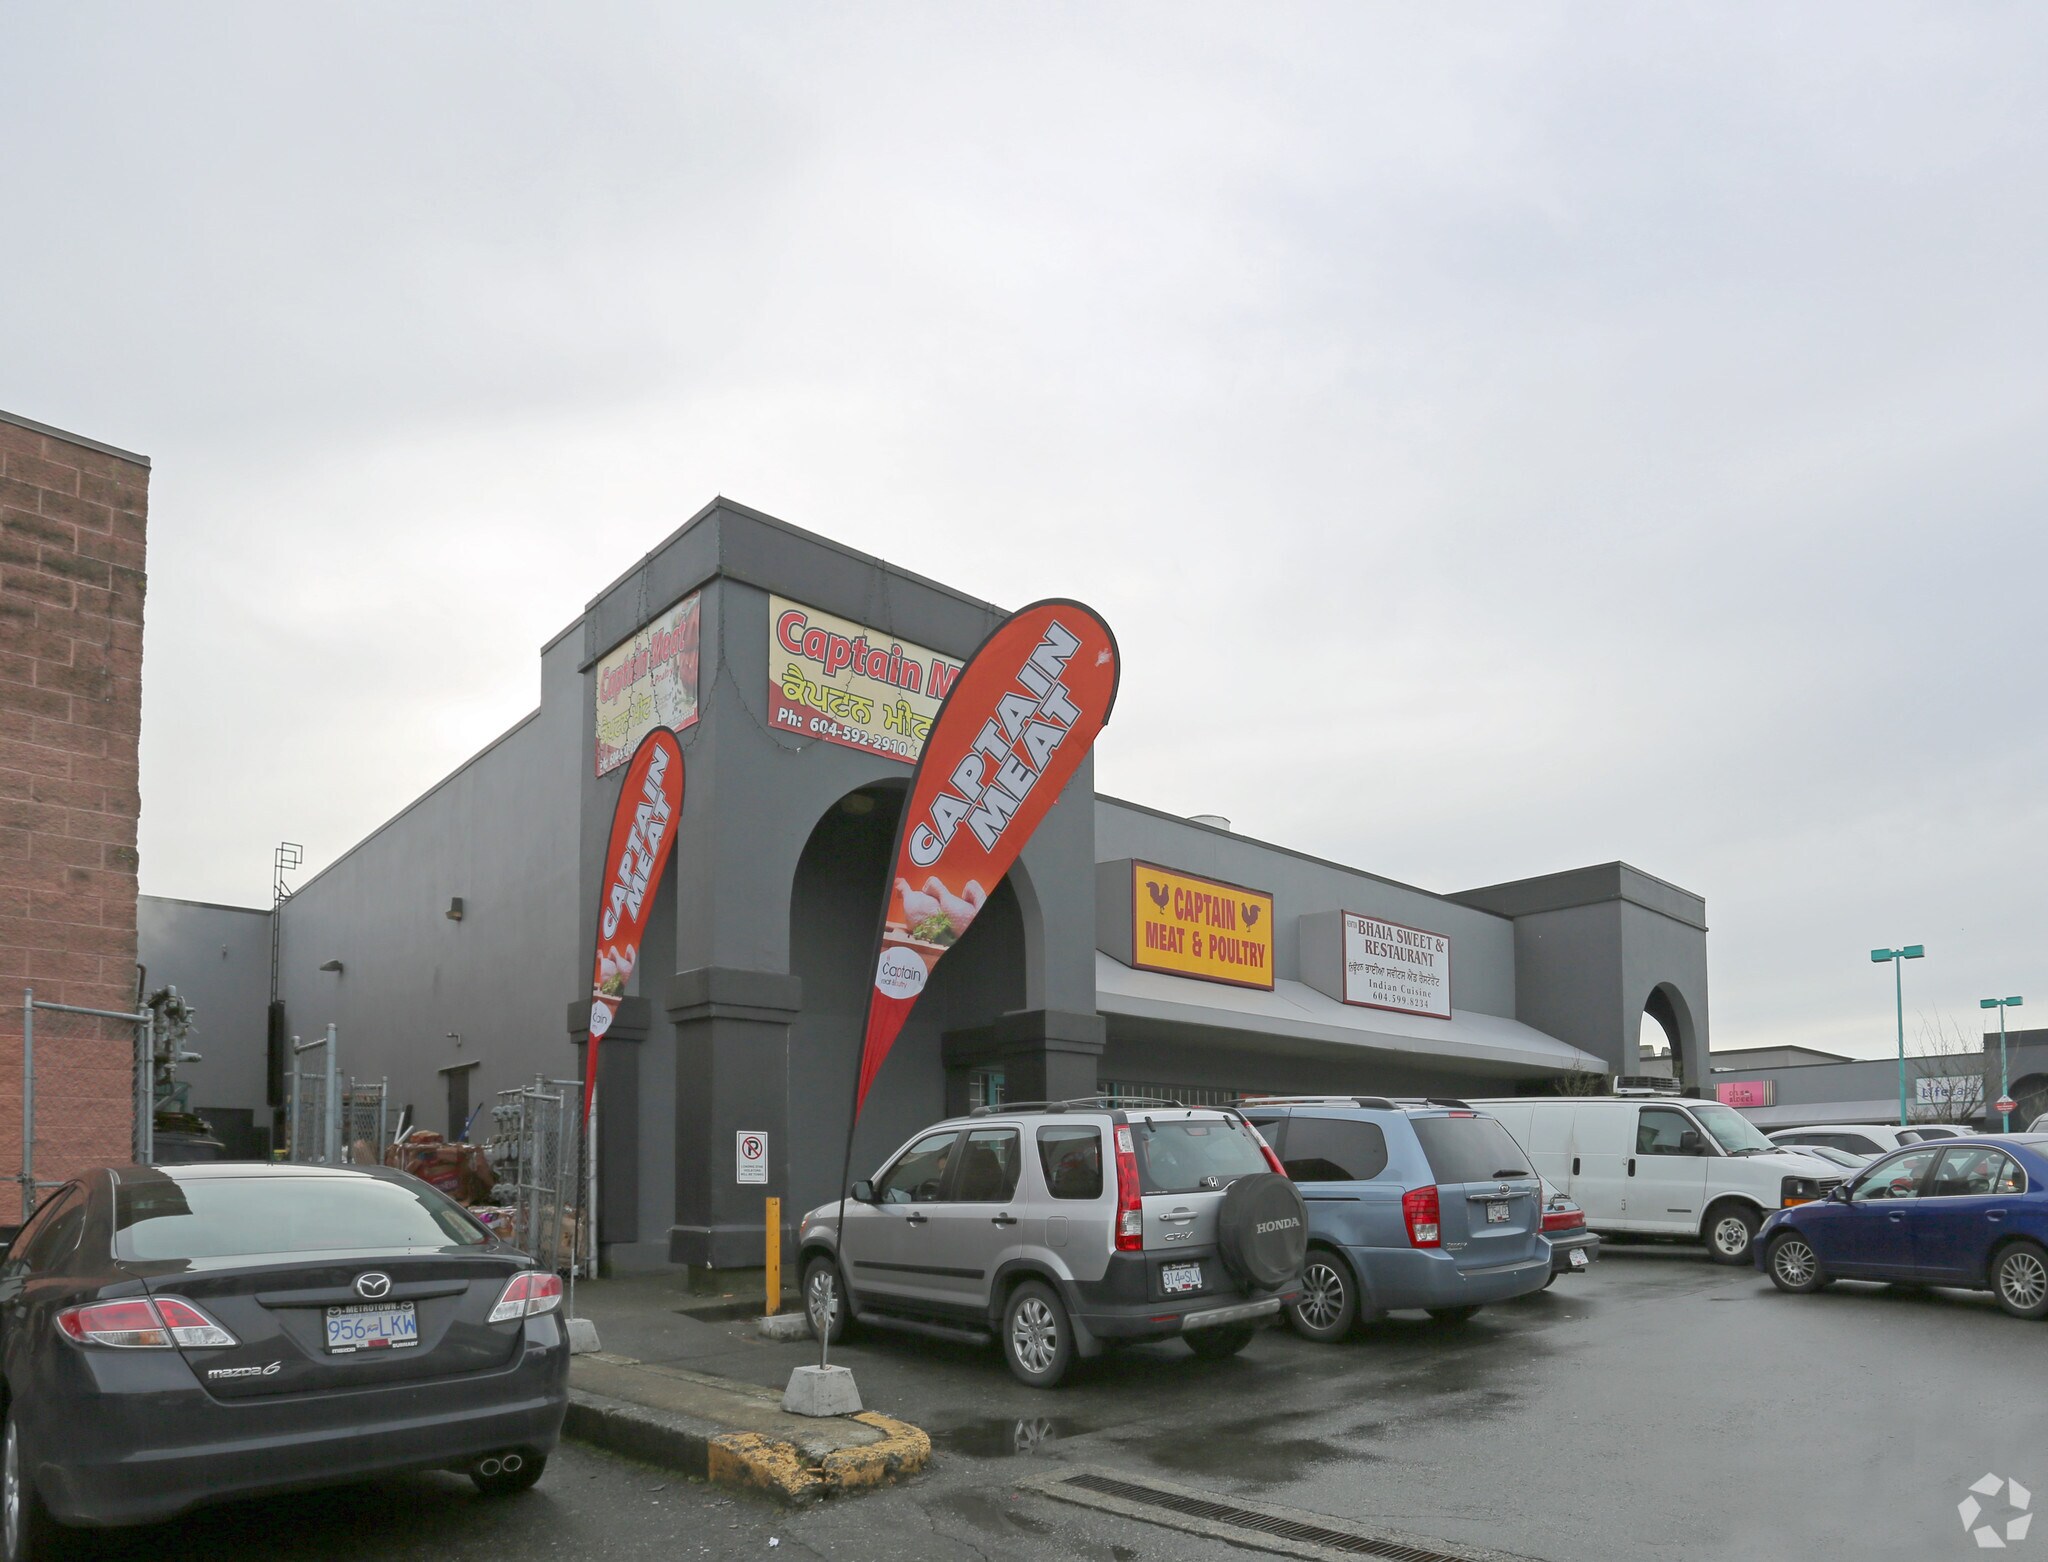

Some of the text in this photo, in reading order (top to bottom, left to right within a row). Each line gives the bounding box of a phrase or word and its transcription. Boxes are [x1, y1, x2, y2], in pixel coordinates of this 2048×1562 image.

[650, 620, 686, 671] Meat
[776, 609, 924, 695] Captain
[781, 663, 874, 724] ਕੈਪਟਨ
[777, 706, 907, 756] Ph: 604-592-2910
[908, 620, 1083, 867] CAPTAIN
[964, 681, 1083, 854] MEAT
[603, 743, 670, 941] CAPTAIN
[624, 789, 671, 923] MEAT
[1174, 887, 1236, 931] CAPTAIN
[1145, 920, 1265, 968] MEAT & POULTRY
[1358, 920, 1393, 942] BHAIA
[1397, 929, 1432, 950] SWEET
[1435, 938, 1444, 953] &
[1365, 939, 1434, 967] RESTAURANT
[882, 962, 921, 981] Captain
[1369, 979, 1432, 998] Indian Cuisine
[1372, 991, 1429, 1008] 604.599.8234
[1256, 1217, 1300, 1234] HONDA
[328, 1314, 416, 1341] 956 LKW
